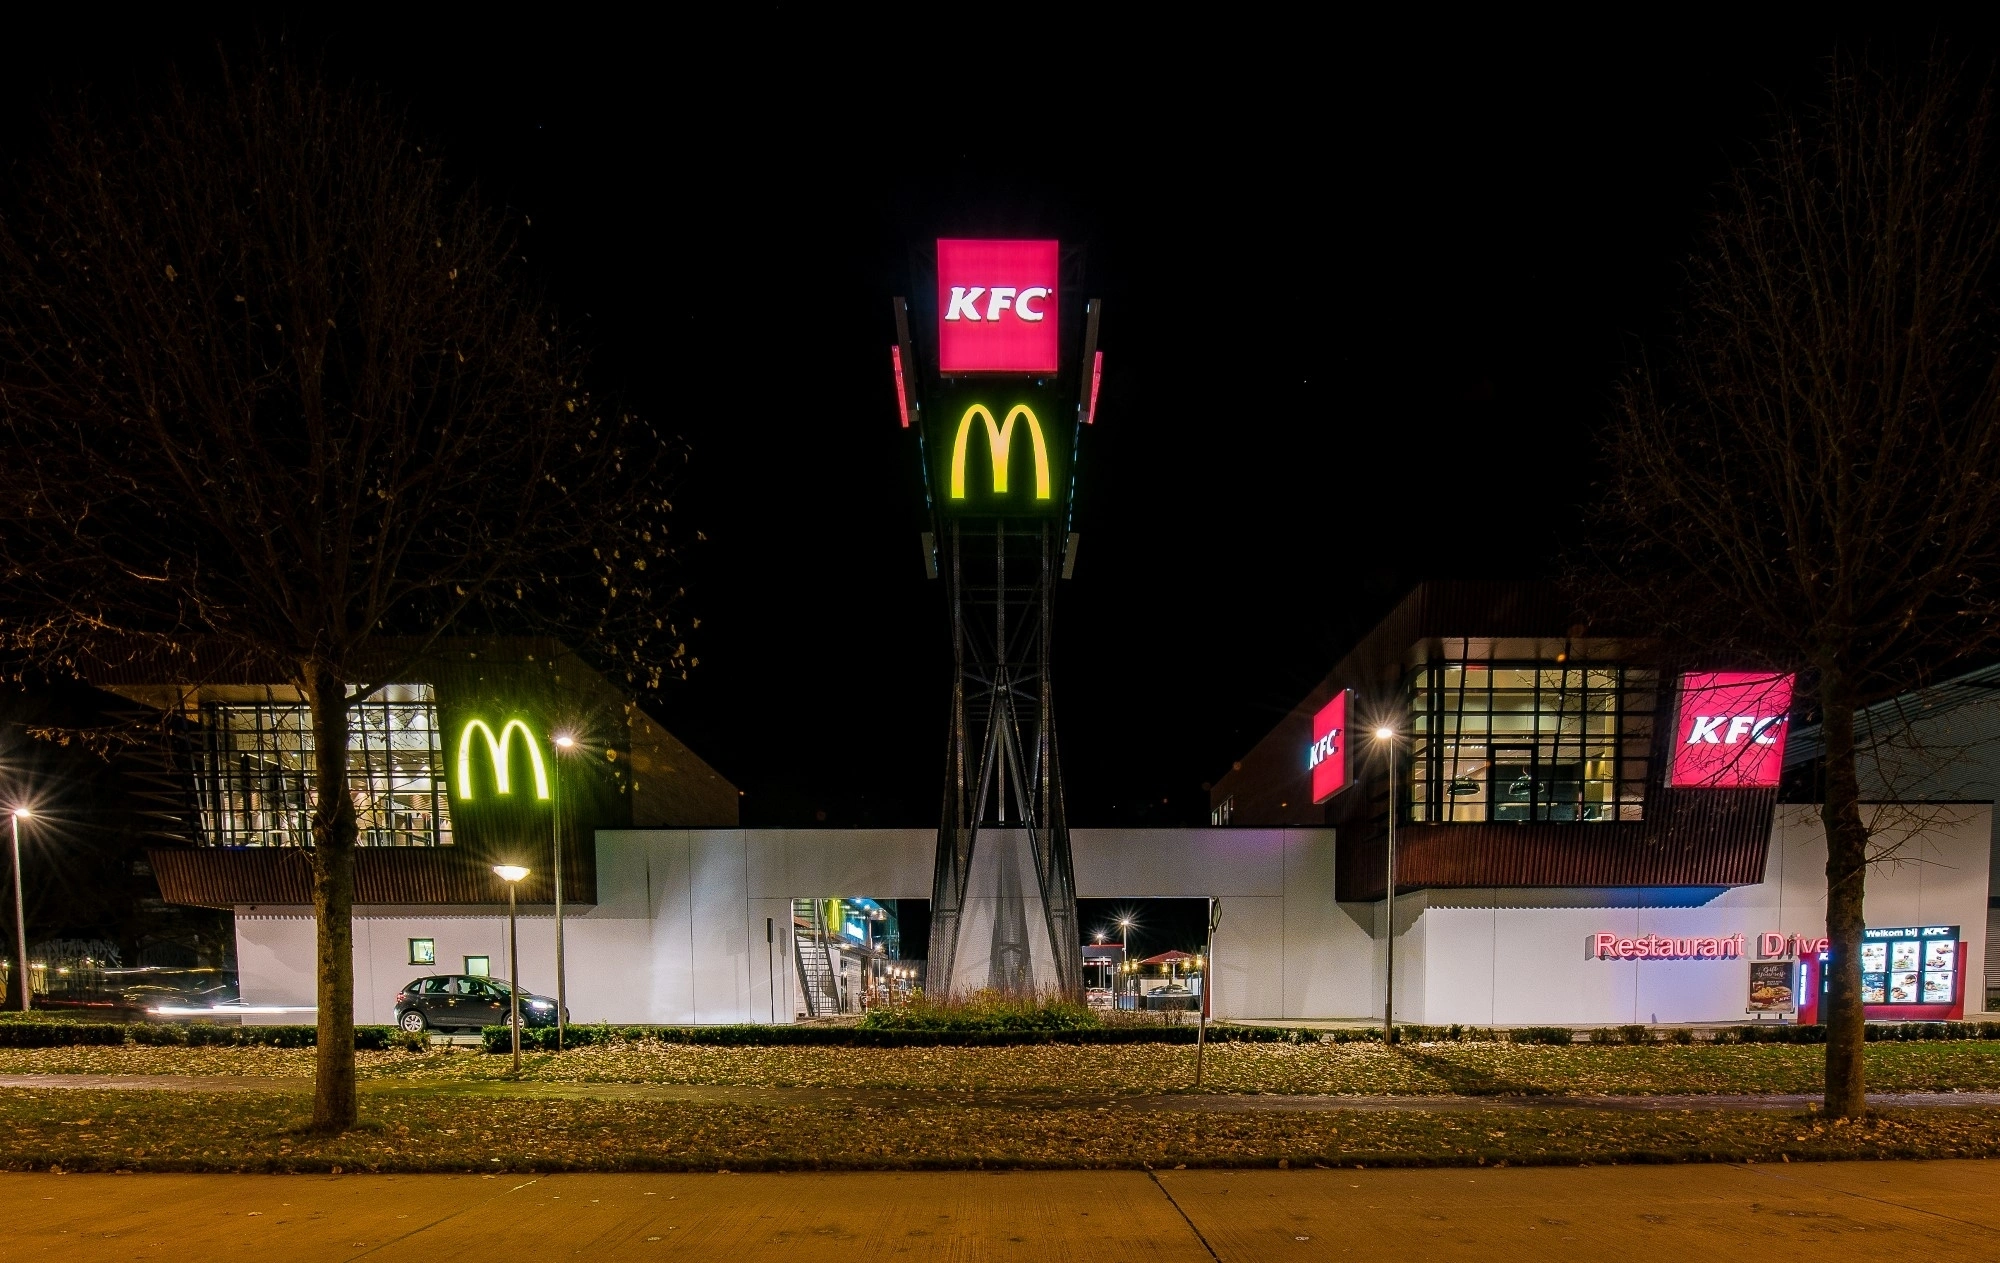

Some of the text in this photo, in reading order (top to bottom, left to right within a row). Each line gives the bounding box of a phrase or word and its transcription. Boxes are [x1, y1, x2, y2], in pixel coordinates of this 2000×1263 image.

[944, 286, 1045, 321] KFC
[1686, 716, 1784, 745] KFC
[1309, 728, 1338, 770] KFC
[1596, 933, 1829, 957] Restaurant Drive
[1866, 927, 1949, 938] Welkom bij KFC
